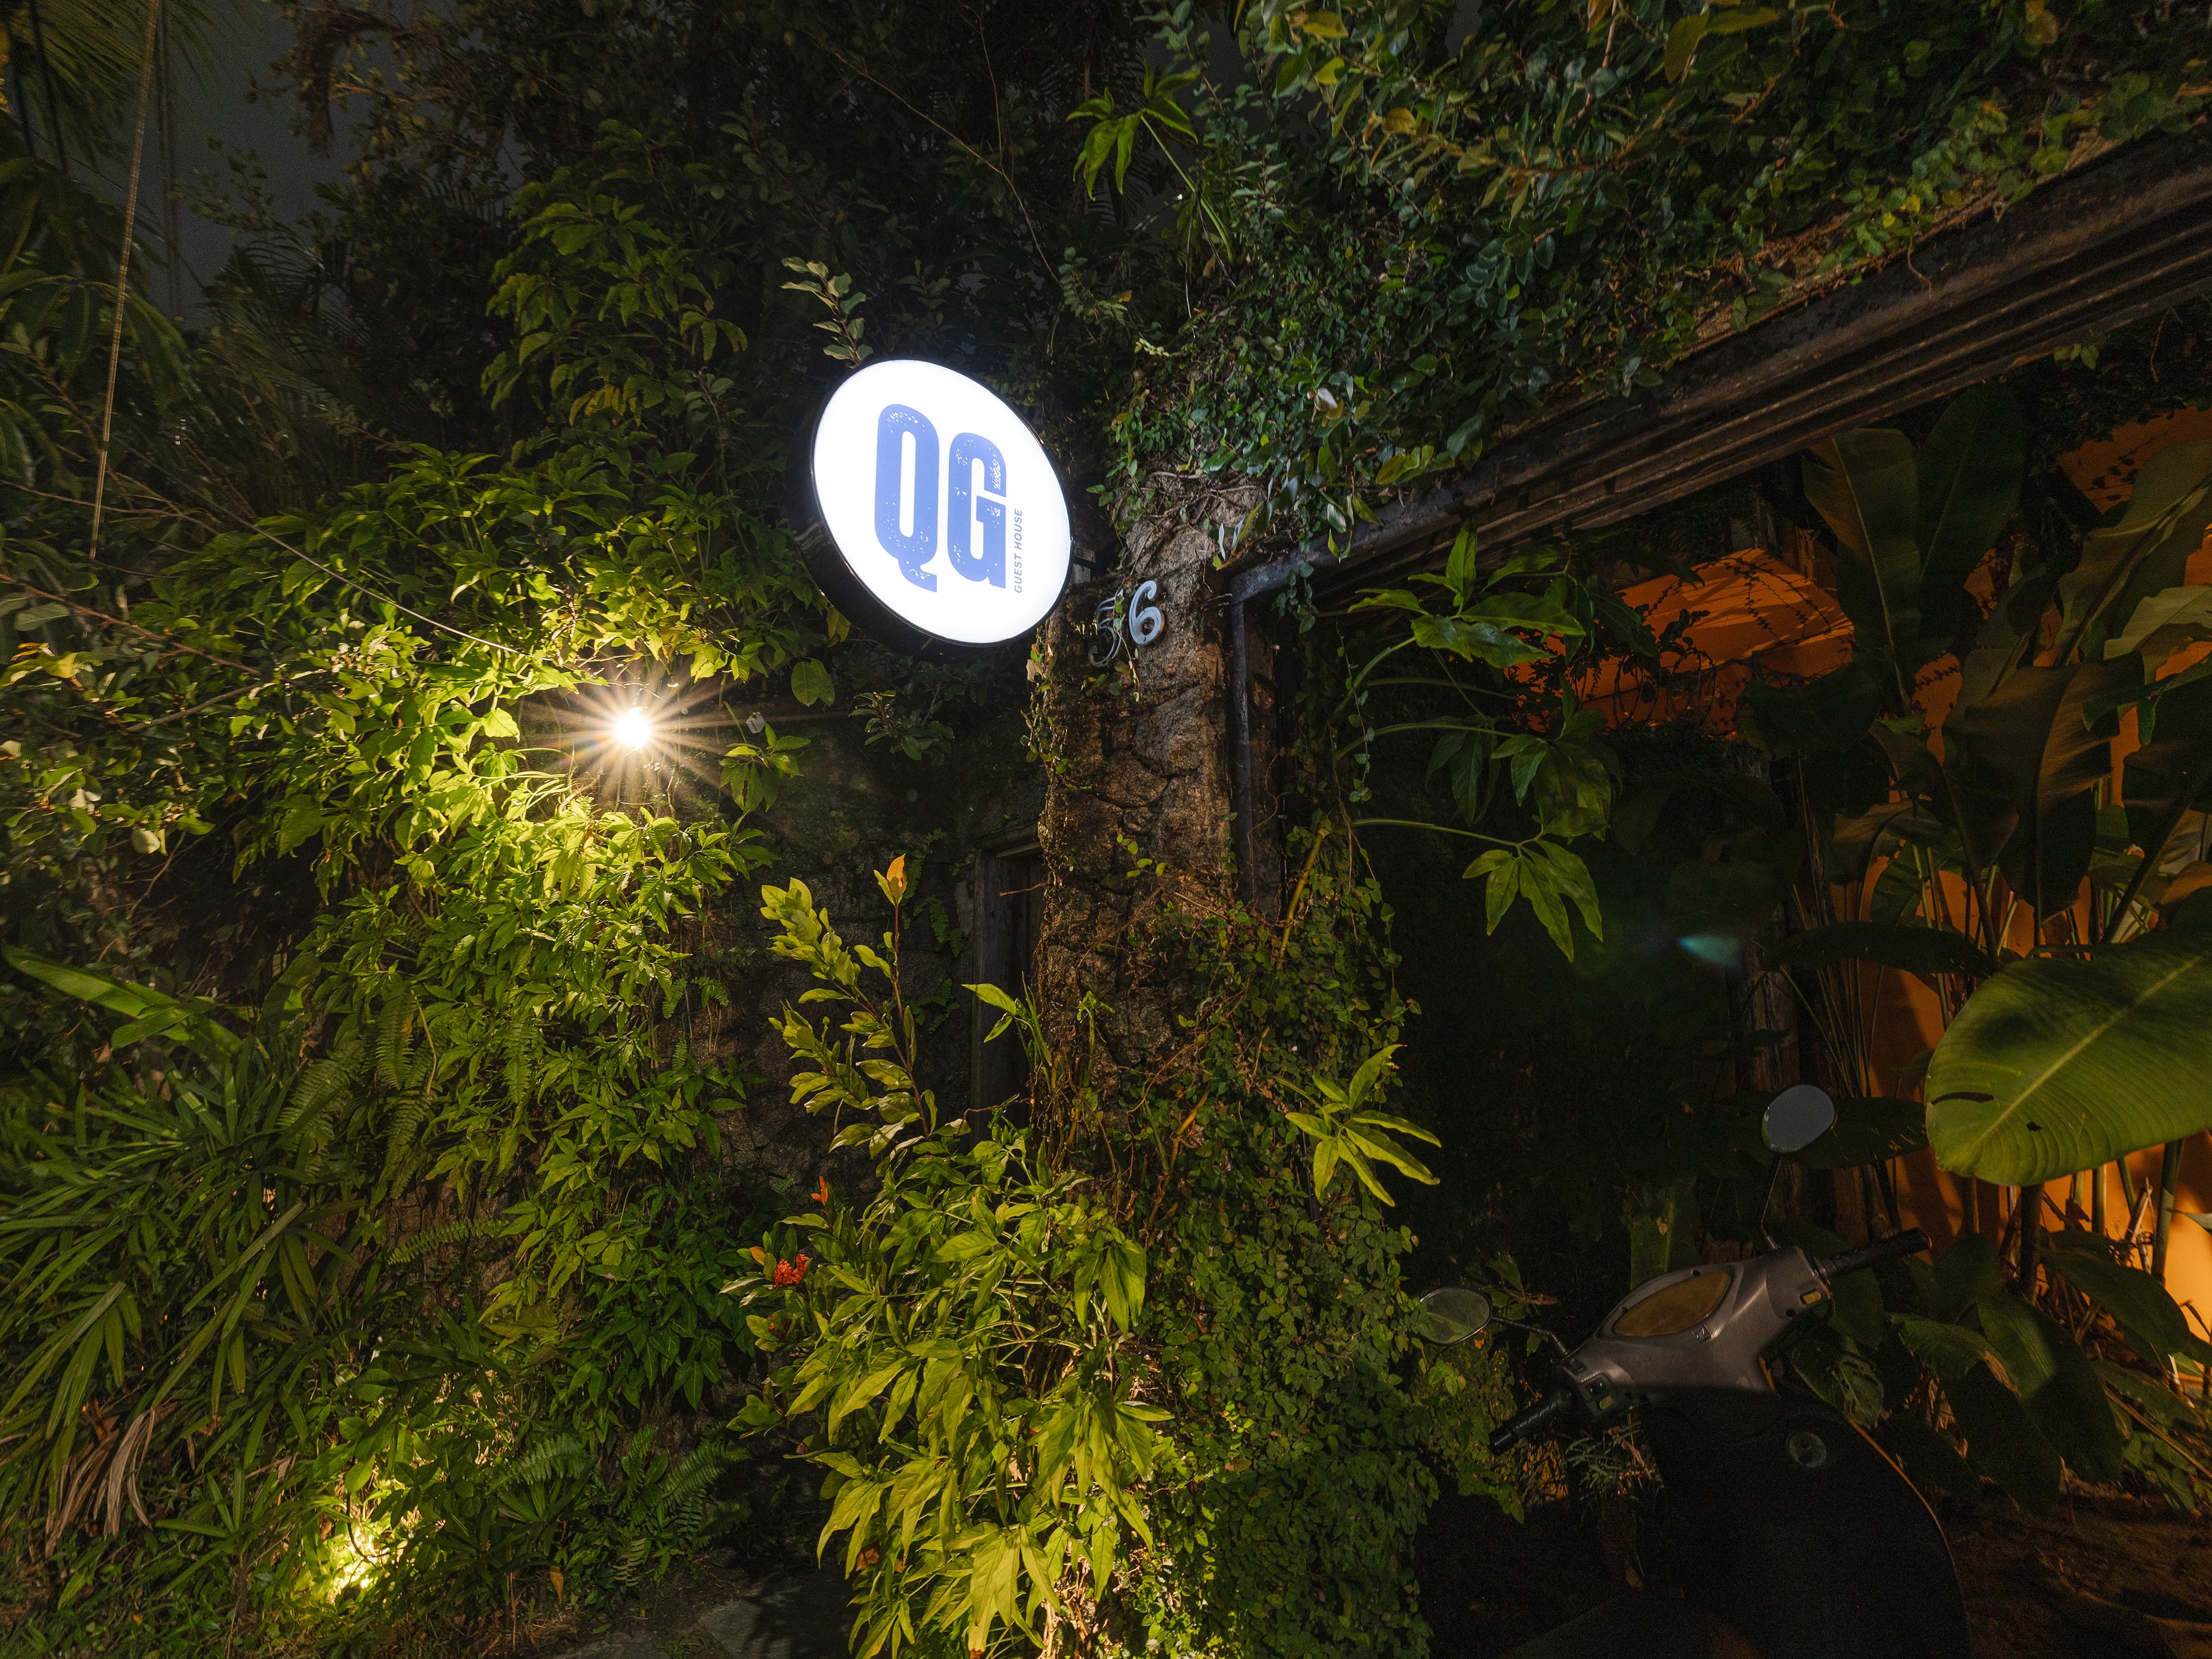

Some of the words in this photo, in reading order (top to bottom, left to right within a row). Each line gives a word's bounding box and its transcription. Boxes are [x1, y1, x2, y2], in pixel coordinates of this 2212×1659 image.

[874, 403, 1007, 593] QG
[1014, 509, 1022, 550] HOUSE
[1014, 552, 1022, 593] GUEST
[1088, 580, 1164, 668] 56
